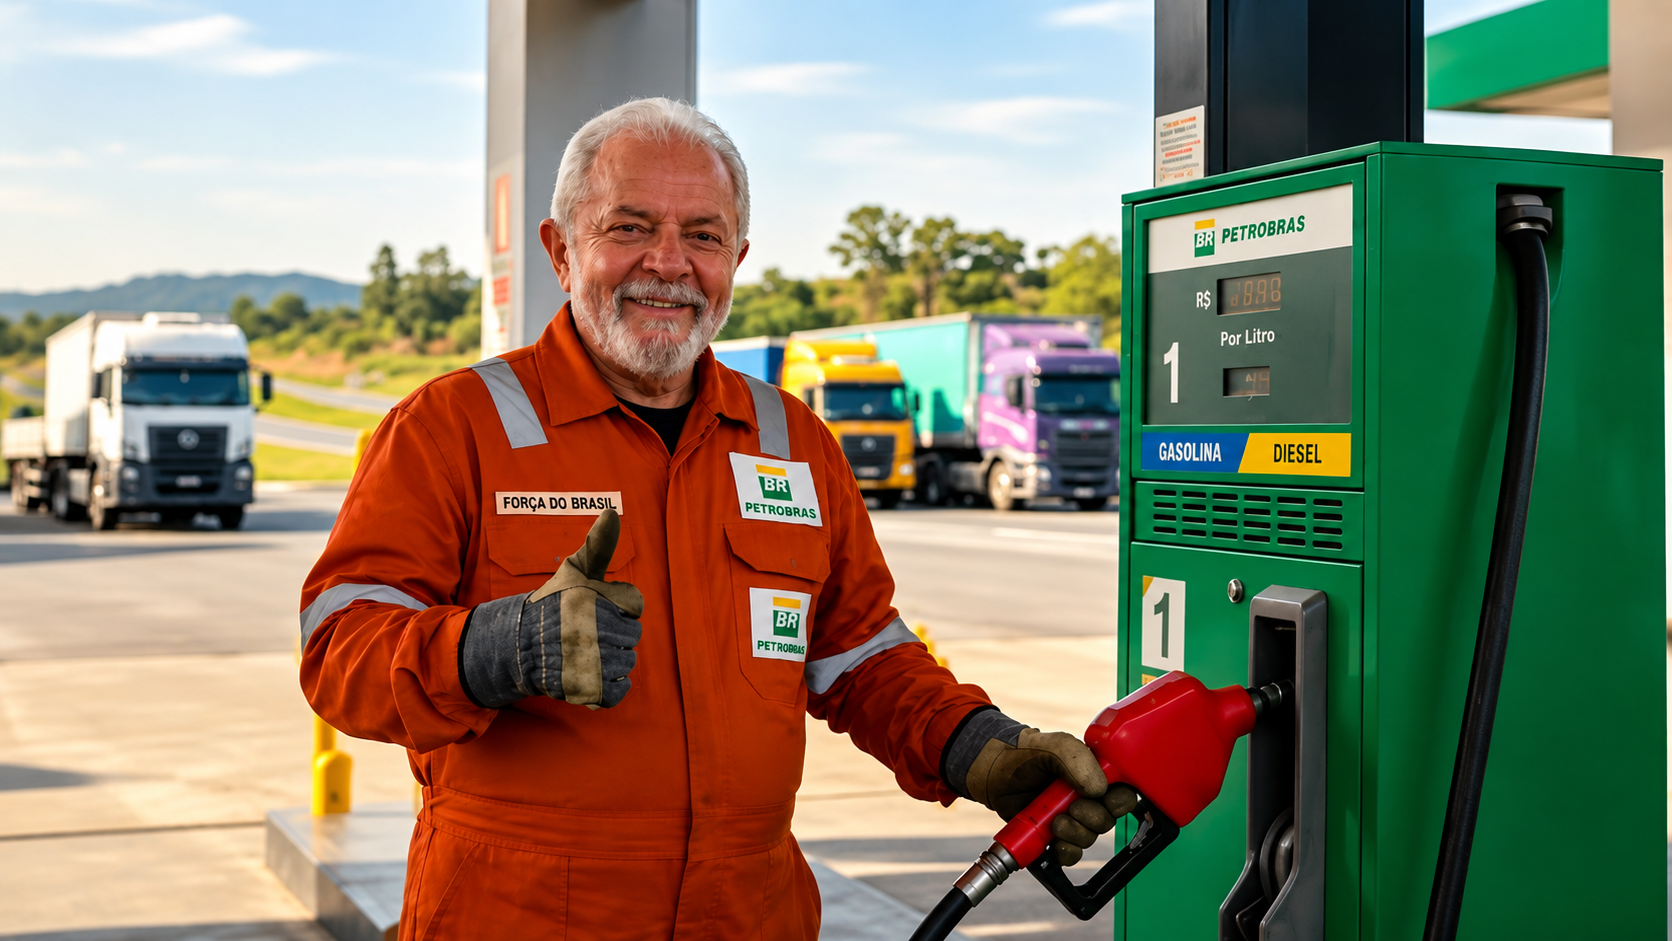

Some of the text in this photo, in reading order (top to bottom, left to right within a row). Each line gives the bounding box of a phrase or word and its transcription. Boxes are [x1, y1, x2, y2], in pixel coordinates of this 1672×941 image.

[1196, 215, 1305, 248] BR PETROBRAS
[1196, 290, 1211, 310] R$
[1220, 328, 1275, 346] Por Litro
[1163, 342, 1179, 403] 1
[1159, 442, 1322, 463] GASOLINA DIESEL
[764, 476, 788, 493] BR
[503, 497, 617, 512] FORÇA DO BRASIL
[745, 502, 817, 519] PETROBRAS
[776, 611, 798, 629] BR
[1154, 592, 1170, 659] 1
